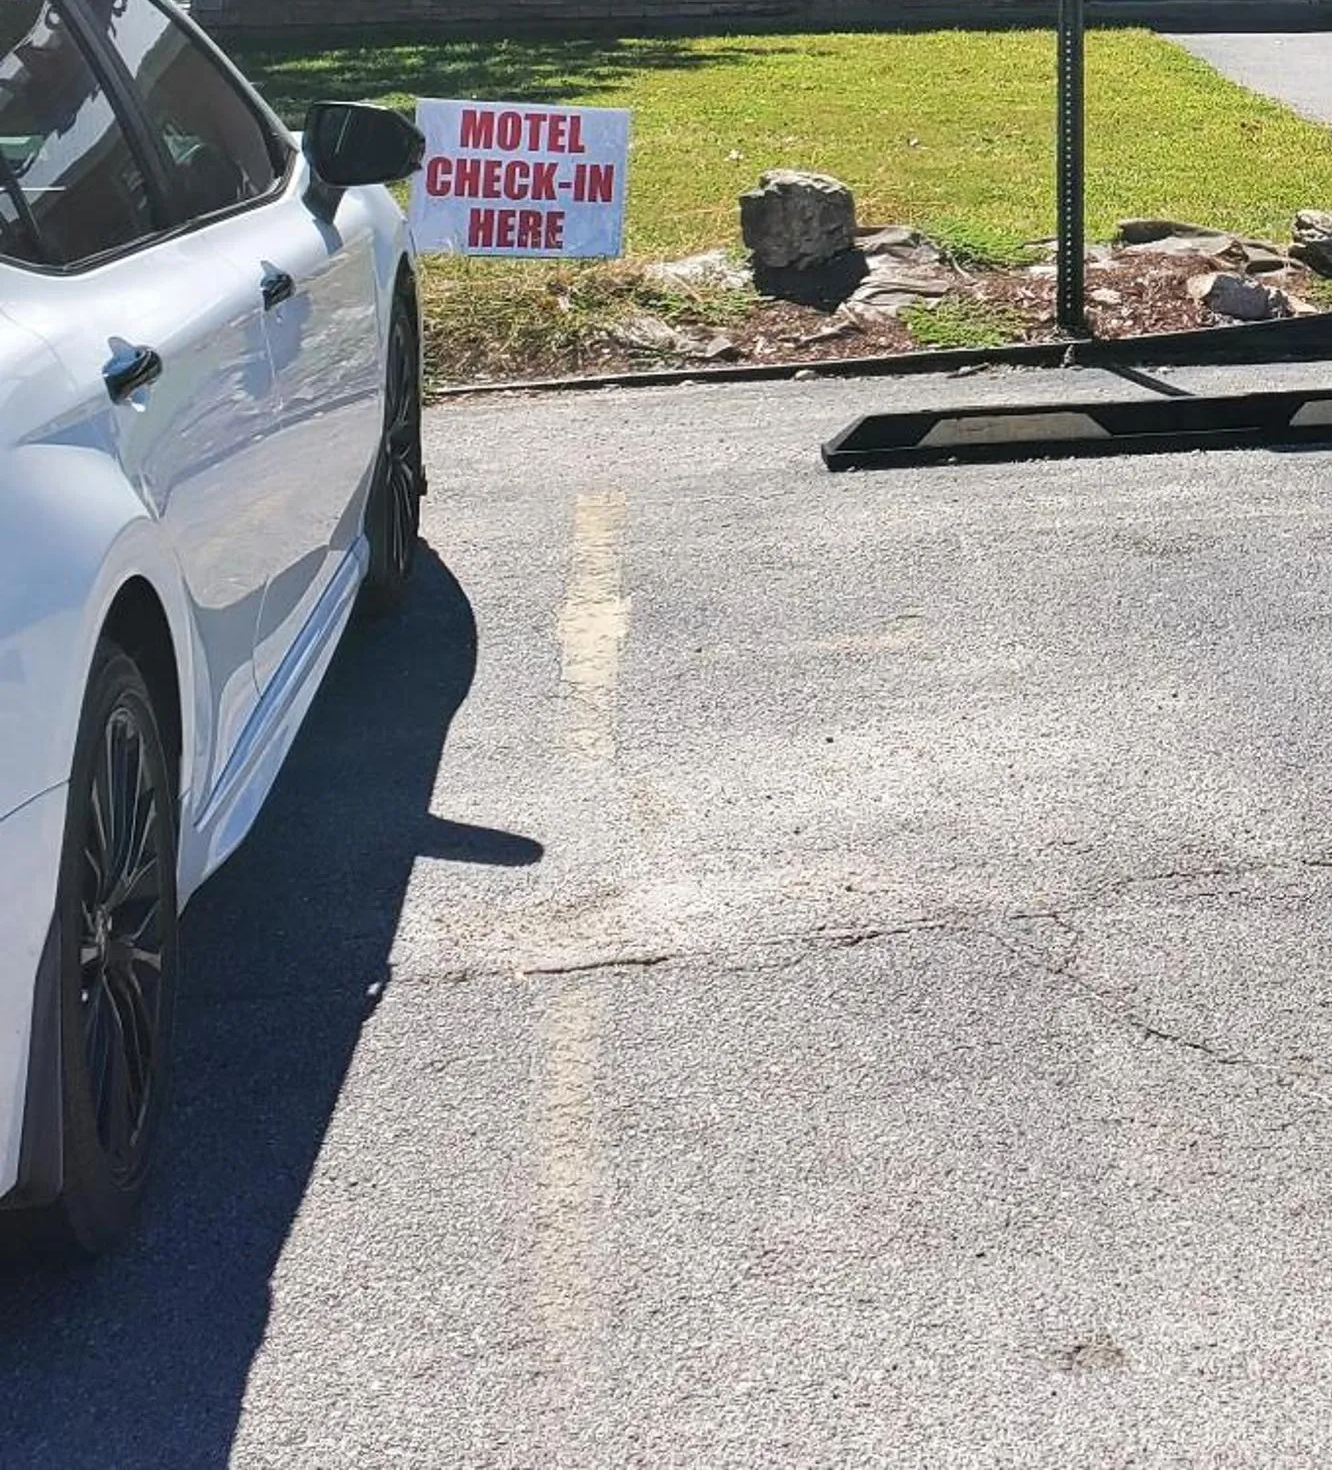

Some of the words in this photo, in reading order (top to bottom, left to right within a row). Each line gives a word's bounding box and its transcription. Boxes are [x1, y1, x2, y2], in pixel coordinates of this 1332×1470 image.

[459, 109, 585, 153] MOTEL
[425, 156, 615, 203] CHECK-IN
[467, 208, 566, 250] HERE
